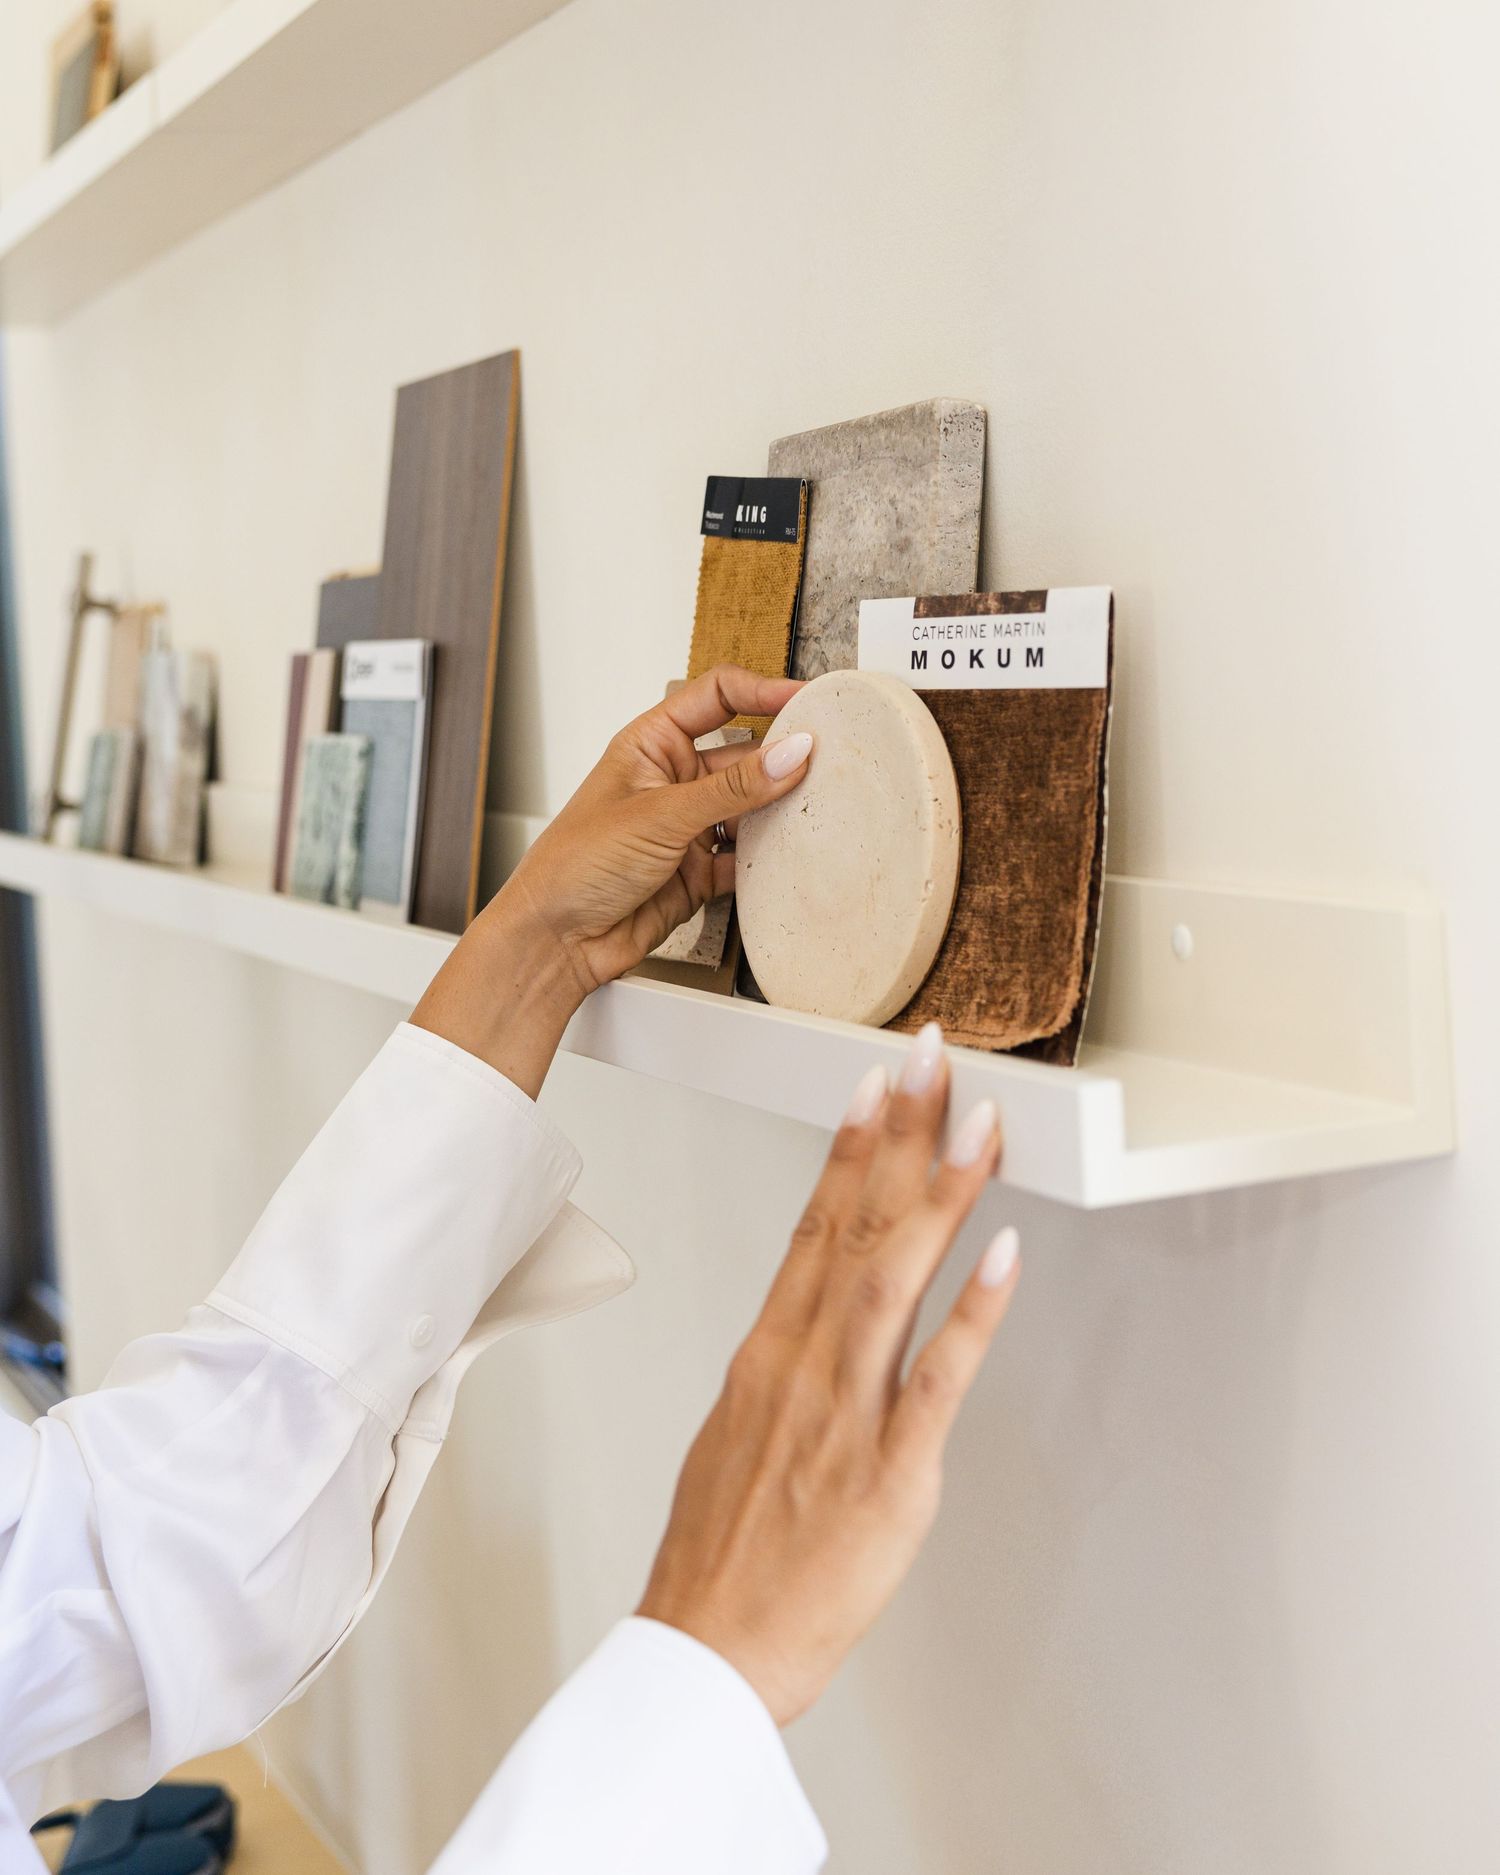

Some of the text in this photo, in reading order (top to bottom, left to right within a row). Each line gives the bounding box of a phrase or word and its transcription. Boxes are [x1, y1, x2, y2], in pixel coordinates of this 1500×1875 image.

[736, 505, 767, 523] KING
[912, 621, 1046, 641] CATHERINE MARTIN
[910, 647, 1044, 670] MOKUM
